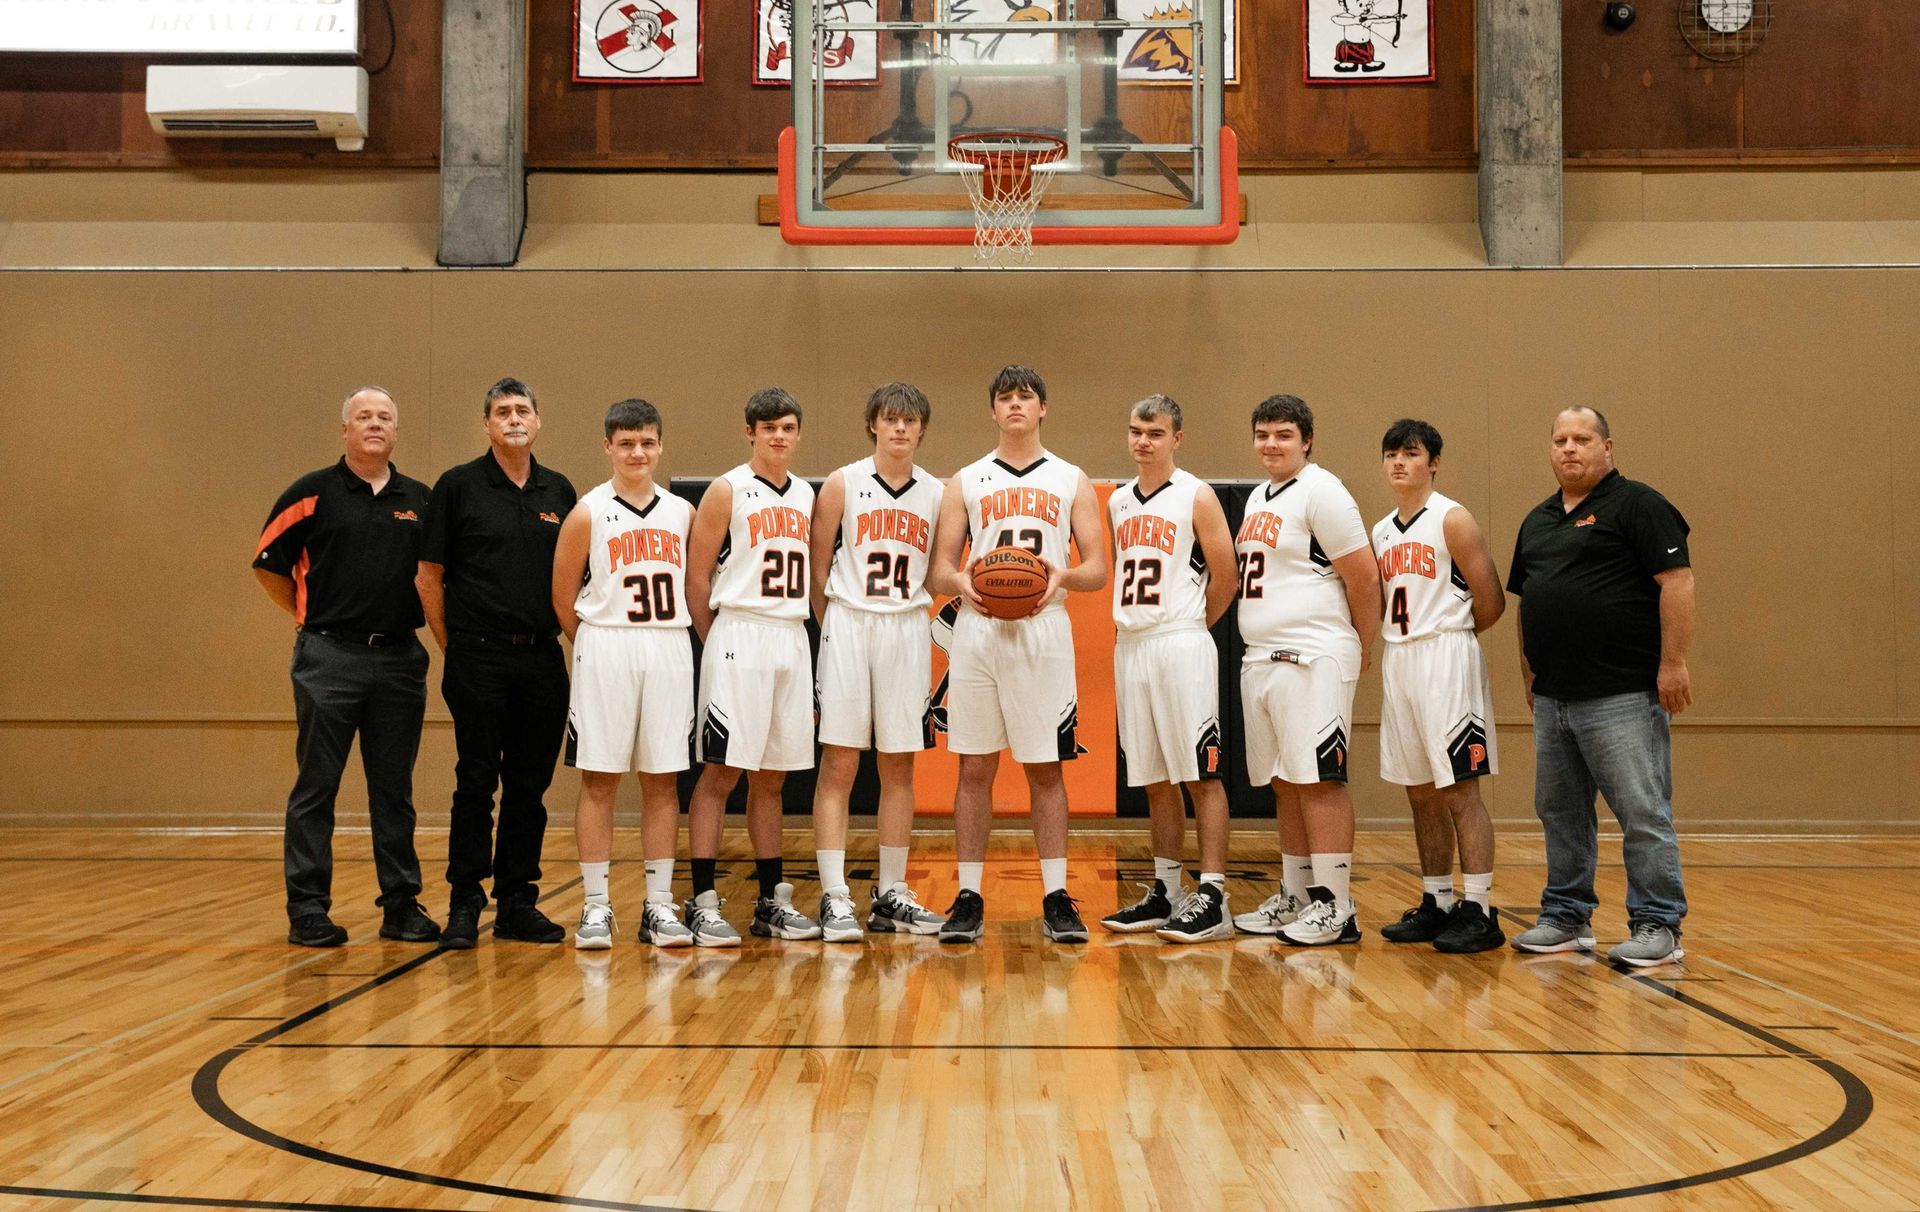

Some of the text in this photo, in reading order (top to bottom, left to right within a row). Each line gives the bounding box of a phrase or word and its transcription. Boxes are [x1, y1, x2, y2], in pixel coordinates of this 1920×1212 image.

[855, 508, 929, 554] POWERS
[979, 486, 1061, 530] POWERS
[1237, 511, 1283, 549] OWERS
[607, 528, 682, 574] POWERS
[761, 549, 805, 599] 20
[984, 552, 1035, 568] Wilson
[623, 572, 676, 623] 30
[866, 551, 910, 600] 24
[985, 577, 1034, 589] EVOLUTION
[1121, 558, 1162, 607] 22
[1391, 587, 1410, 636] 4
[1468, 743, 1486, 771] P
